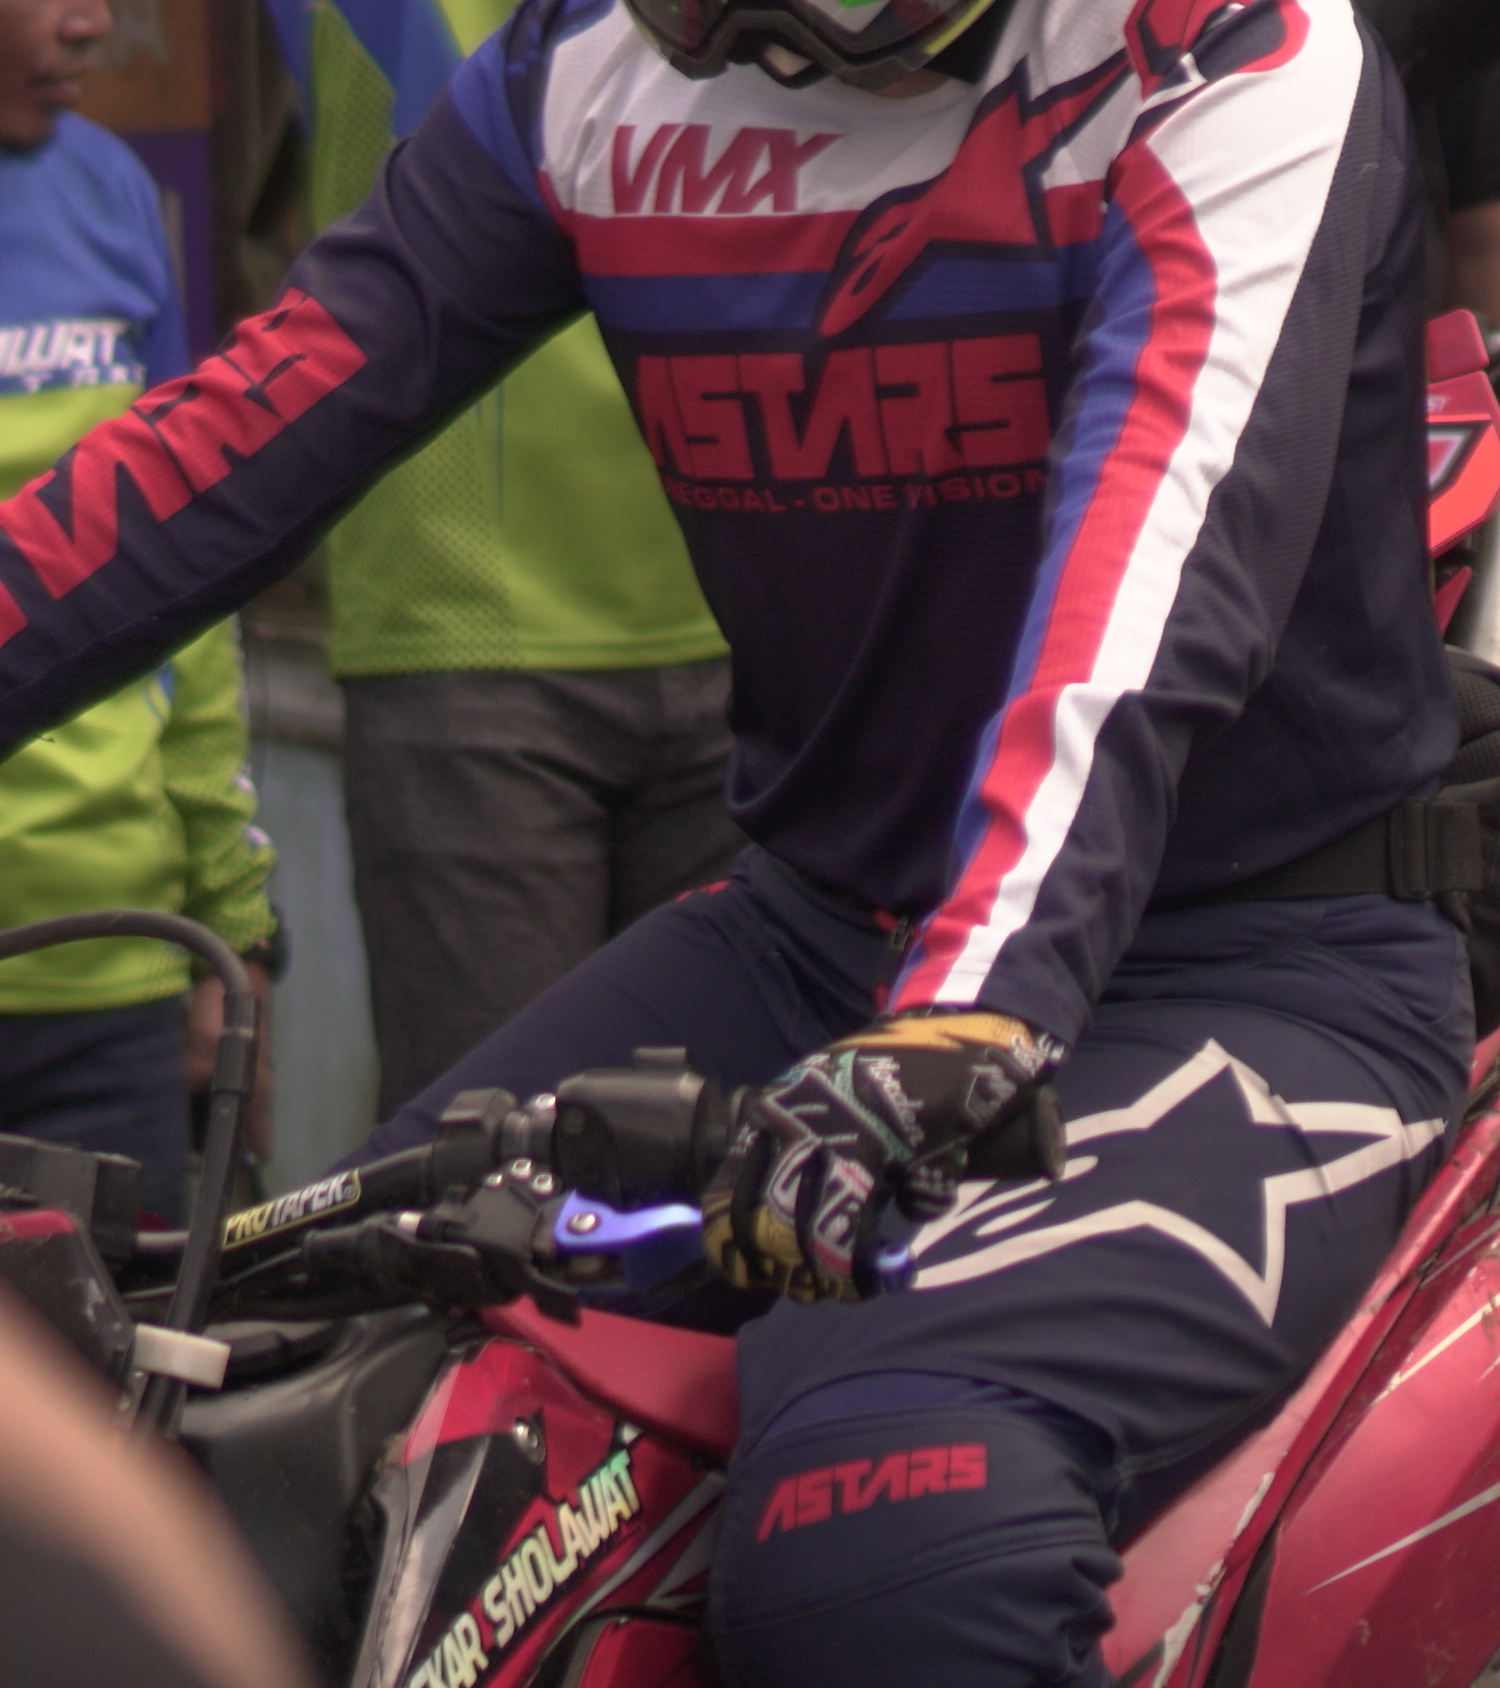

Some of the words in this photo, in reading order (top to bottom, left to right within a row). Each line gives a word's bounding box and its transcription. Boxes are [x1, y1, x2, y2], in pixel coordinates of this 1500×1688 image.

[612, 123, 842, 215] VMX
[812, 483, 896, 512] ONE
[223, 1169, 352, 1248] PROTAPER
[757, 1442, 989, 1543] ASTARS
[481, 1448, 641, 1650] SHOLAWAT
